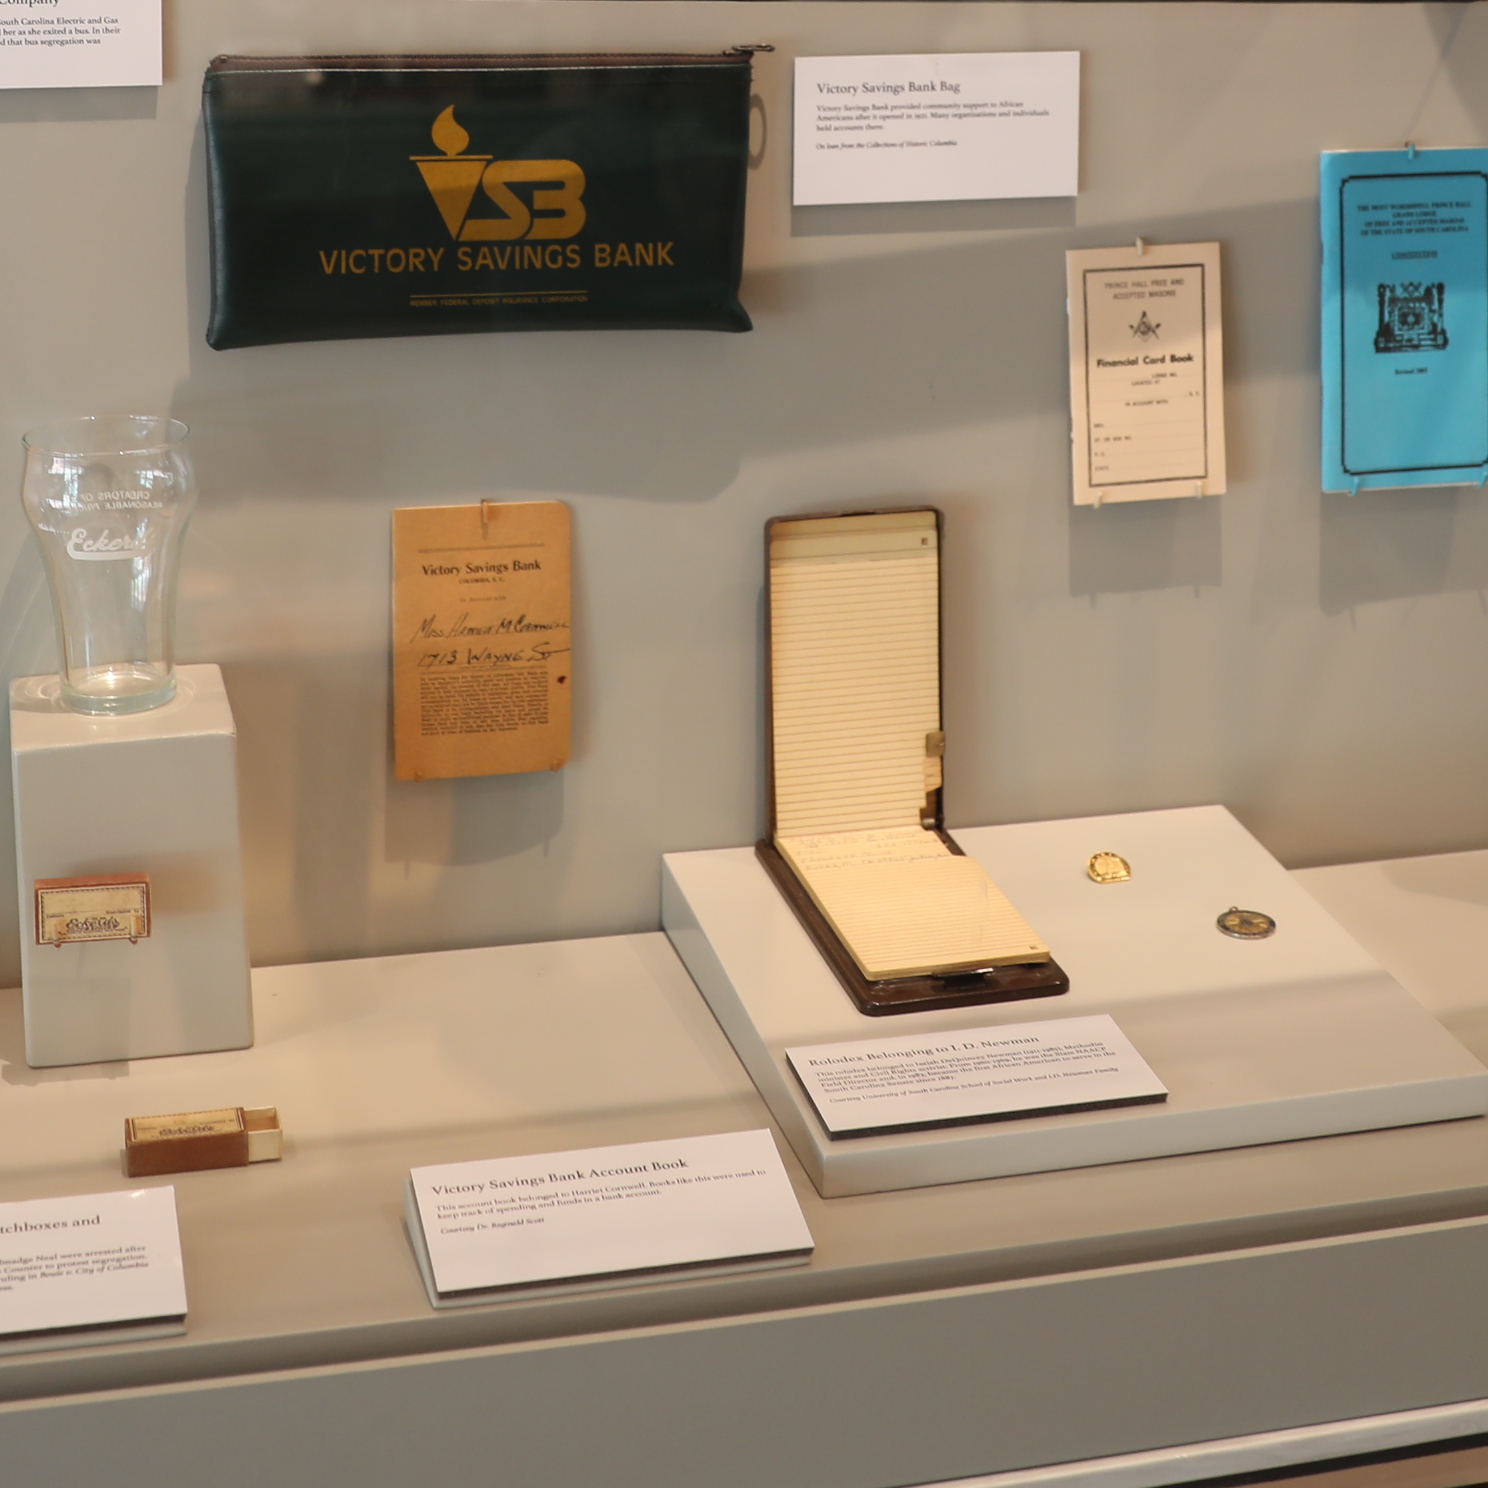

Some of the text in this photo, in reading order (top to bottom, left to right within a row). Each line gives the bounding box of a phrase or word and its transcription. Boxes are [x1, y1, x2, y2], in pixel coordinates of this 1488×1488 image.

[817, 81, 961, 95] Victory Savings Bank Bag
[319, 241, 675, 276] VICTORY SAVINGS BANK
[1097, 353, 1194, 368] Financial Card Book
[422, 559, 541, 576] Victory Savings Bank
[808, 1036, 1040, 1068] Rolodex Belonging Newman
[431, 1157, 690, 1198] Victory Savings Bank Account Book
